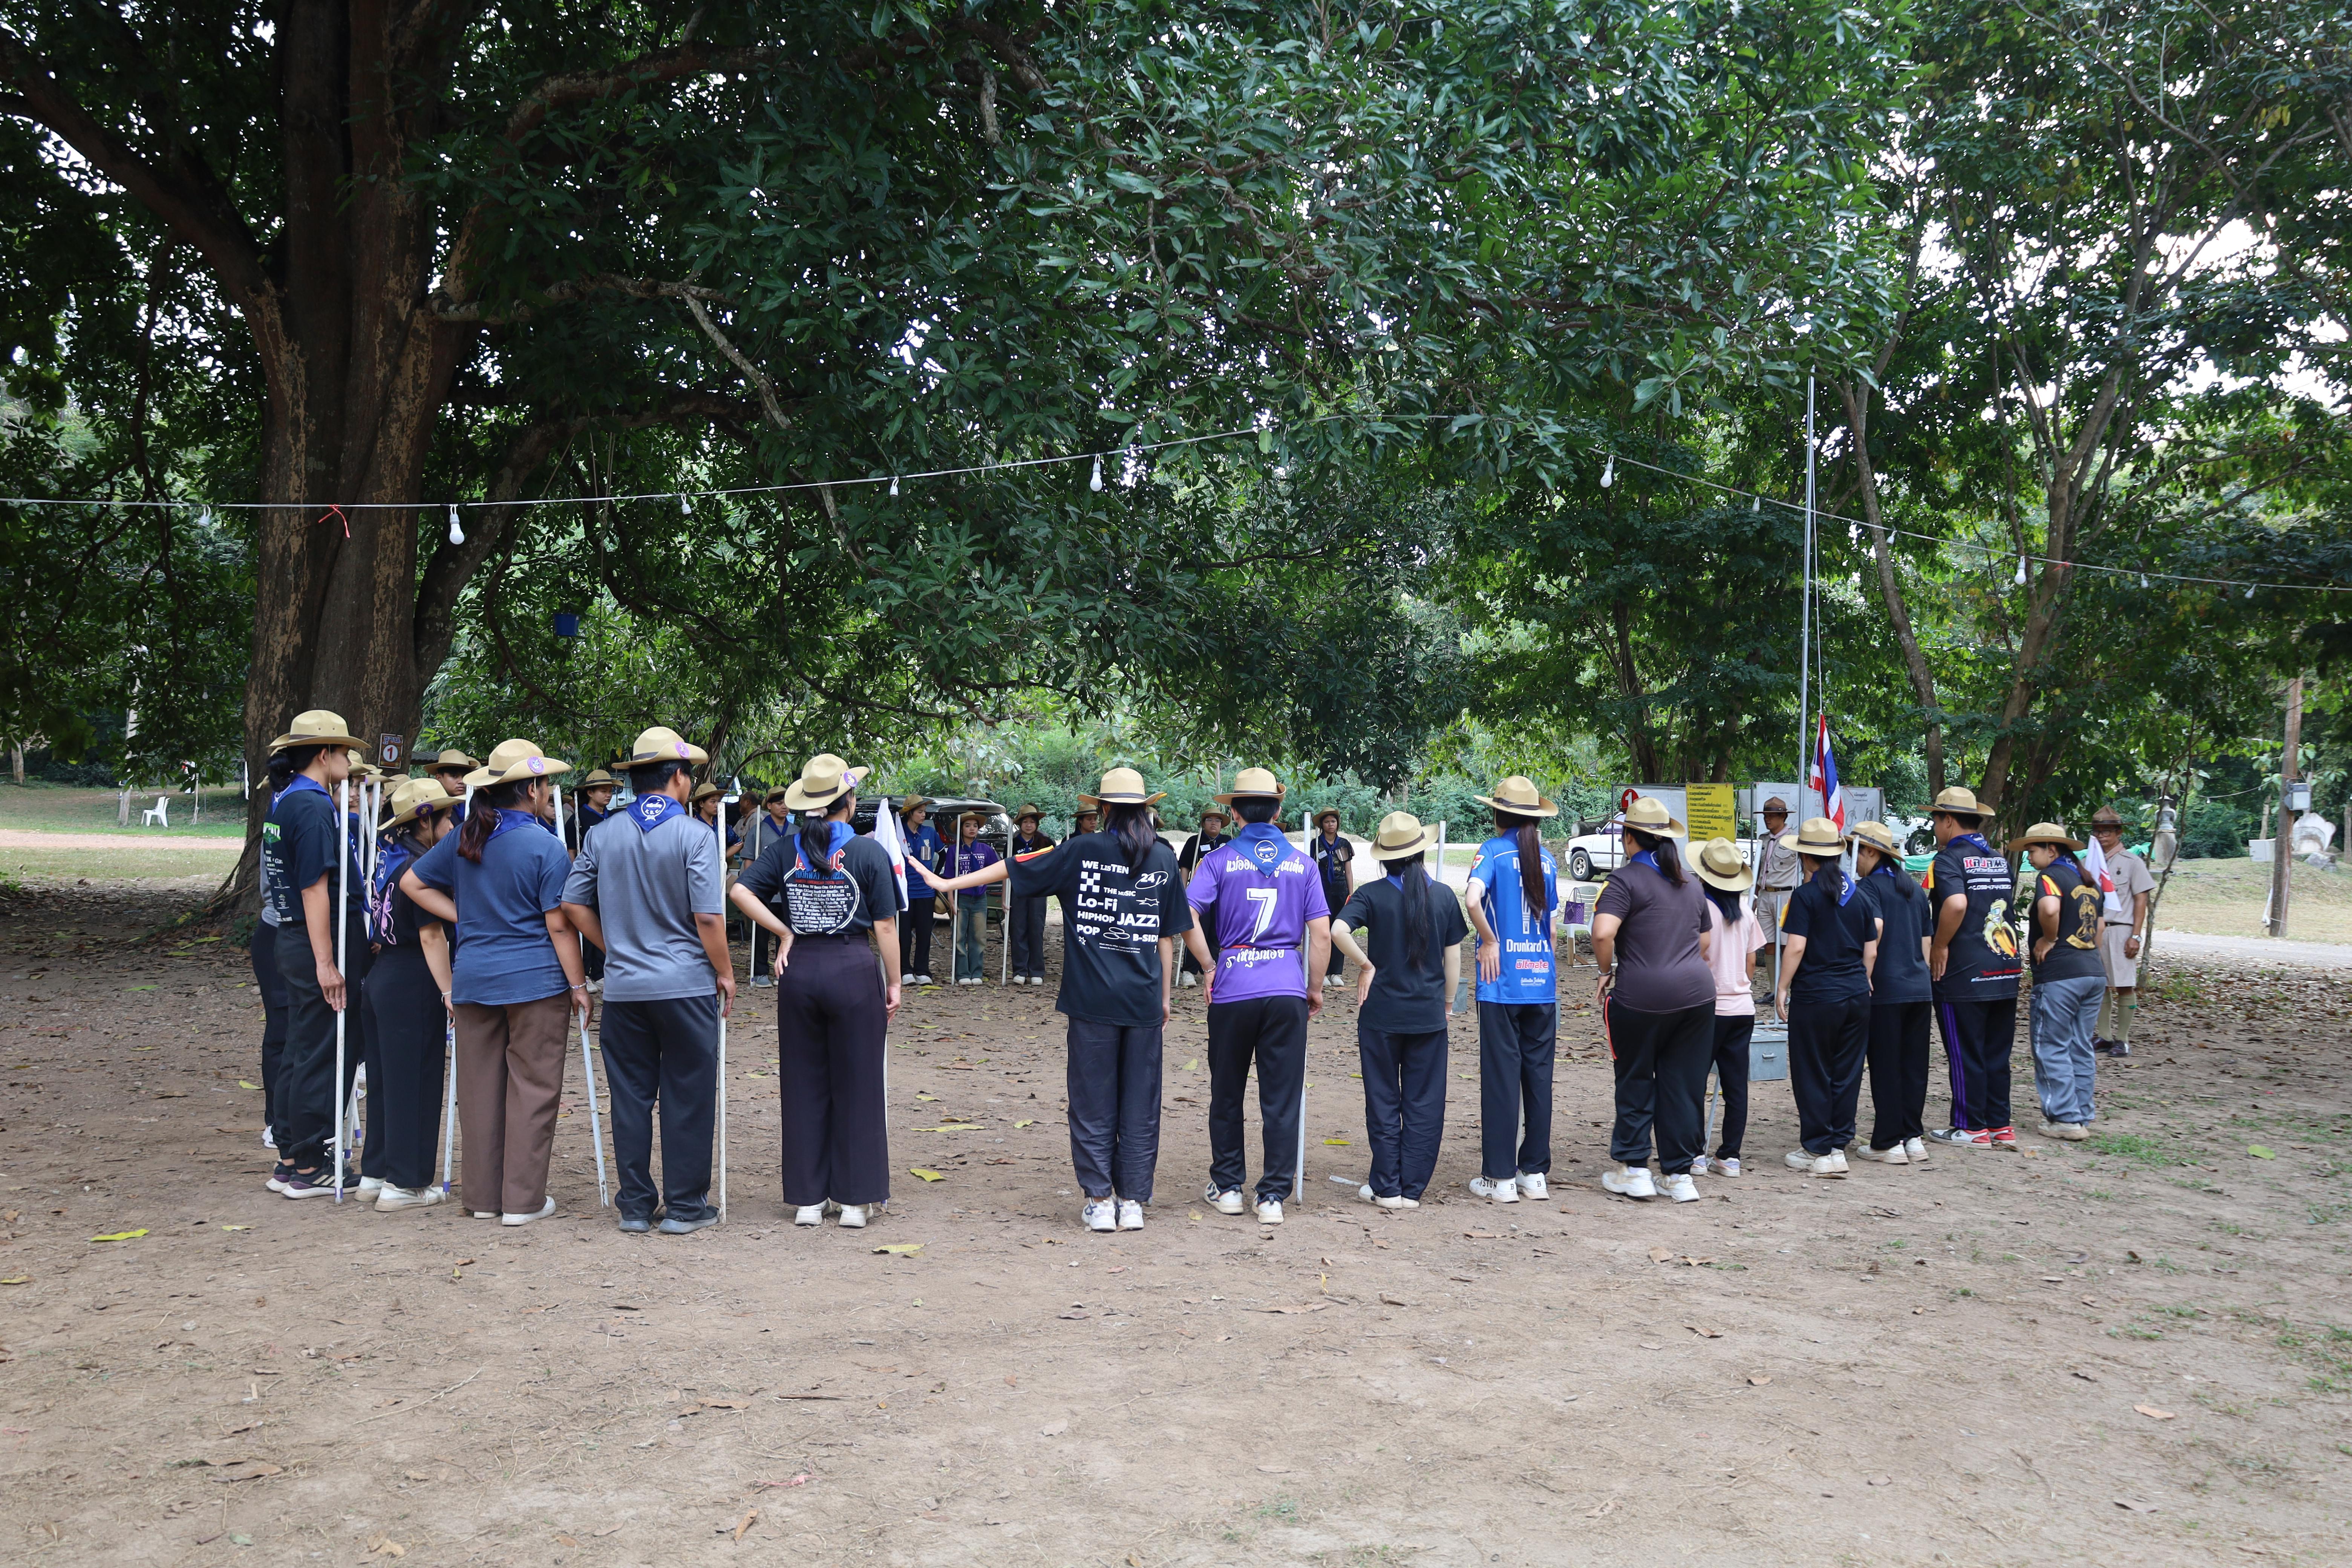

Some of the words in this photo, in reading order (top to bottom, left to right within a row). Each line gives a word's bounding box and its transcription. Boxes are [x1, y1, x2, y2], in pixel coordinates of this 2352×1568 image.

[383, 736, 401, 745] ฐาน
[387, 747, 393, 760] 1
[1082, 860, 1099, 870] WE
[1100, 864, 1129, 874] LISTEN
[795, 870, 821, 880] HIGHWAY
[1077, 911, 1115, 923] HIPHOP
[1246, 888, 1277, 943] 7
[1076, 924, 1101, 936] POP
[1506, 939, 1542, 952] Drunkard
